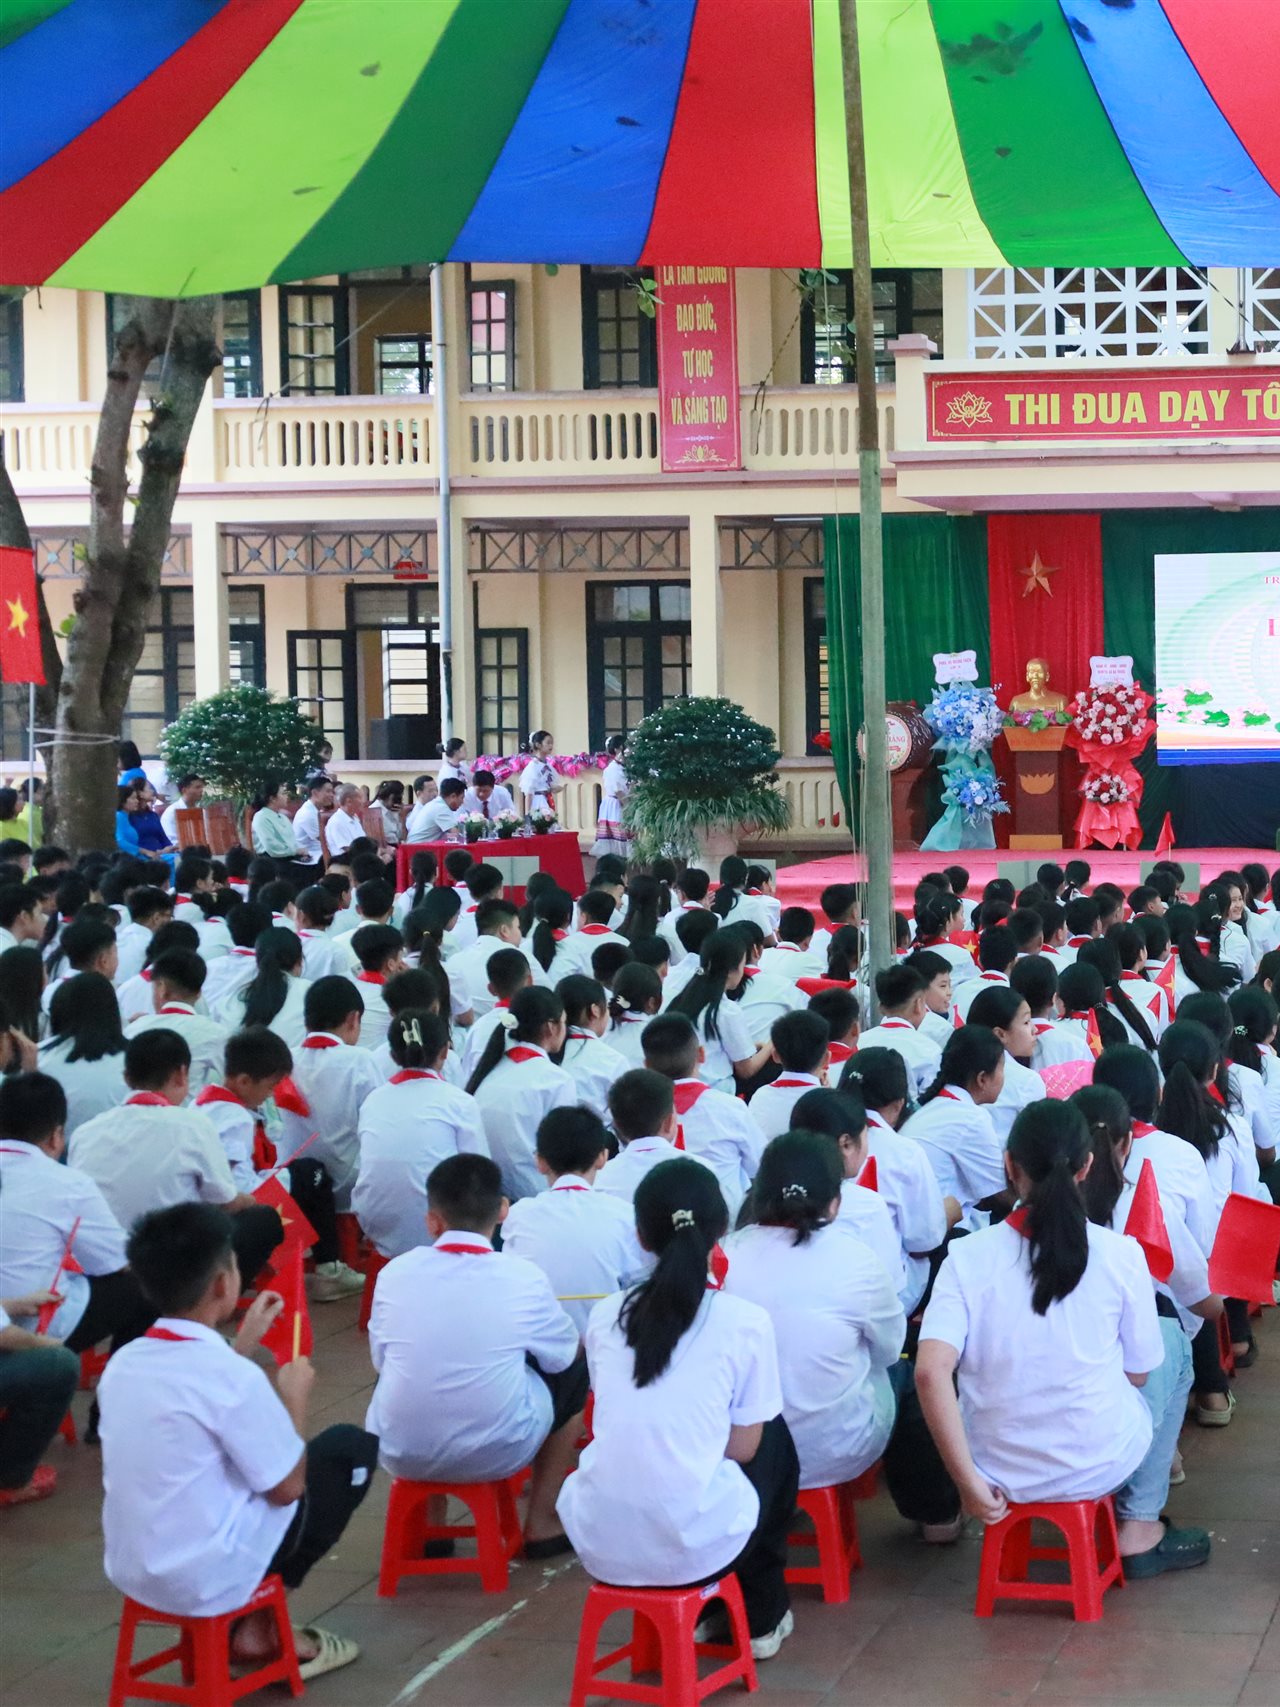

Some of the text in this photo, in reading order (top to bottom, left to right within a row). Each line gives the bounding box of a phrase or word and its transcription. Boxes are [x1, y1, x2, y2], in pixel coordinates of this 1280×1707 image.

[676, 304, 694, 338] ĐẠO
[682, 348, 714, 384] TỰ HỌC
[671, 391, 728, 430] VÀ SÁNG TẠO
[1004, 393, 1060, 425] THI
[1072, 392, 1148, 425] ĐUA
[1159, 389, 1230, 429] DẠY
